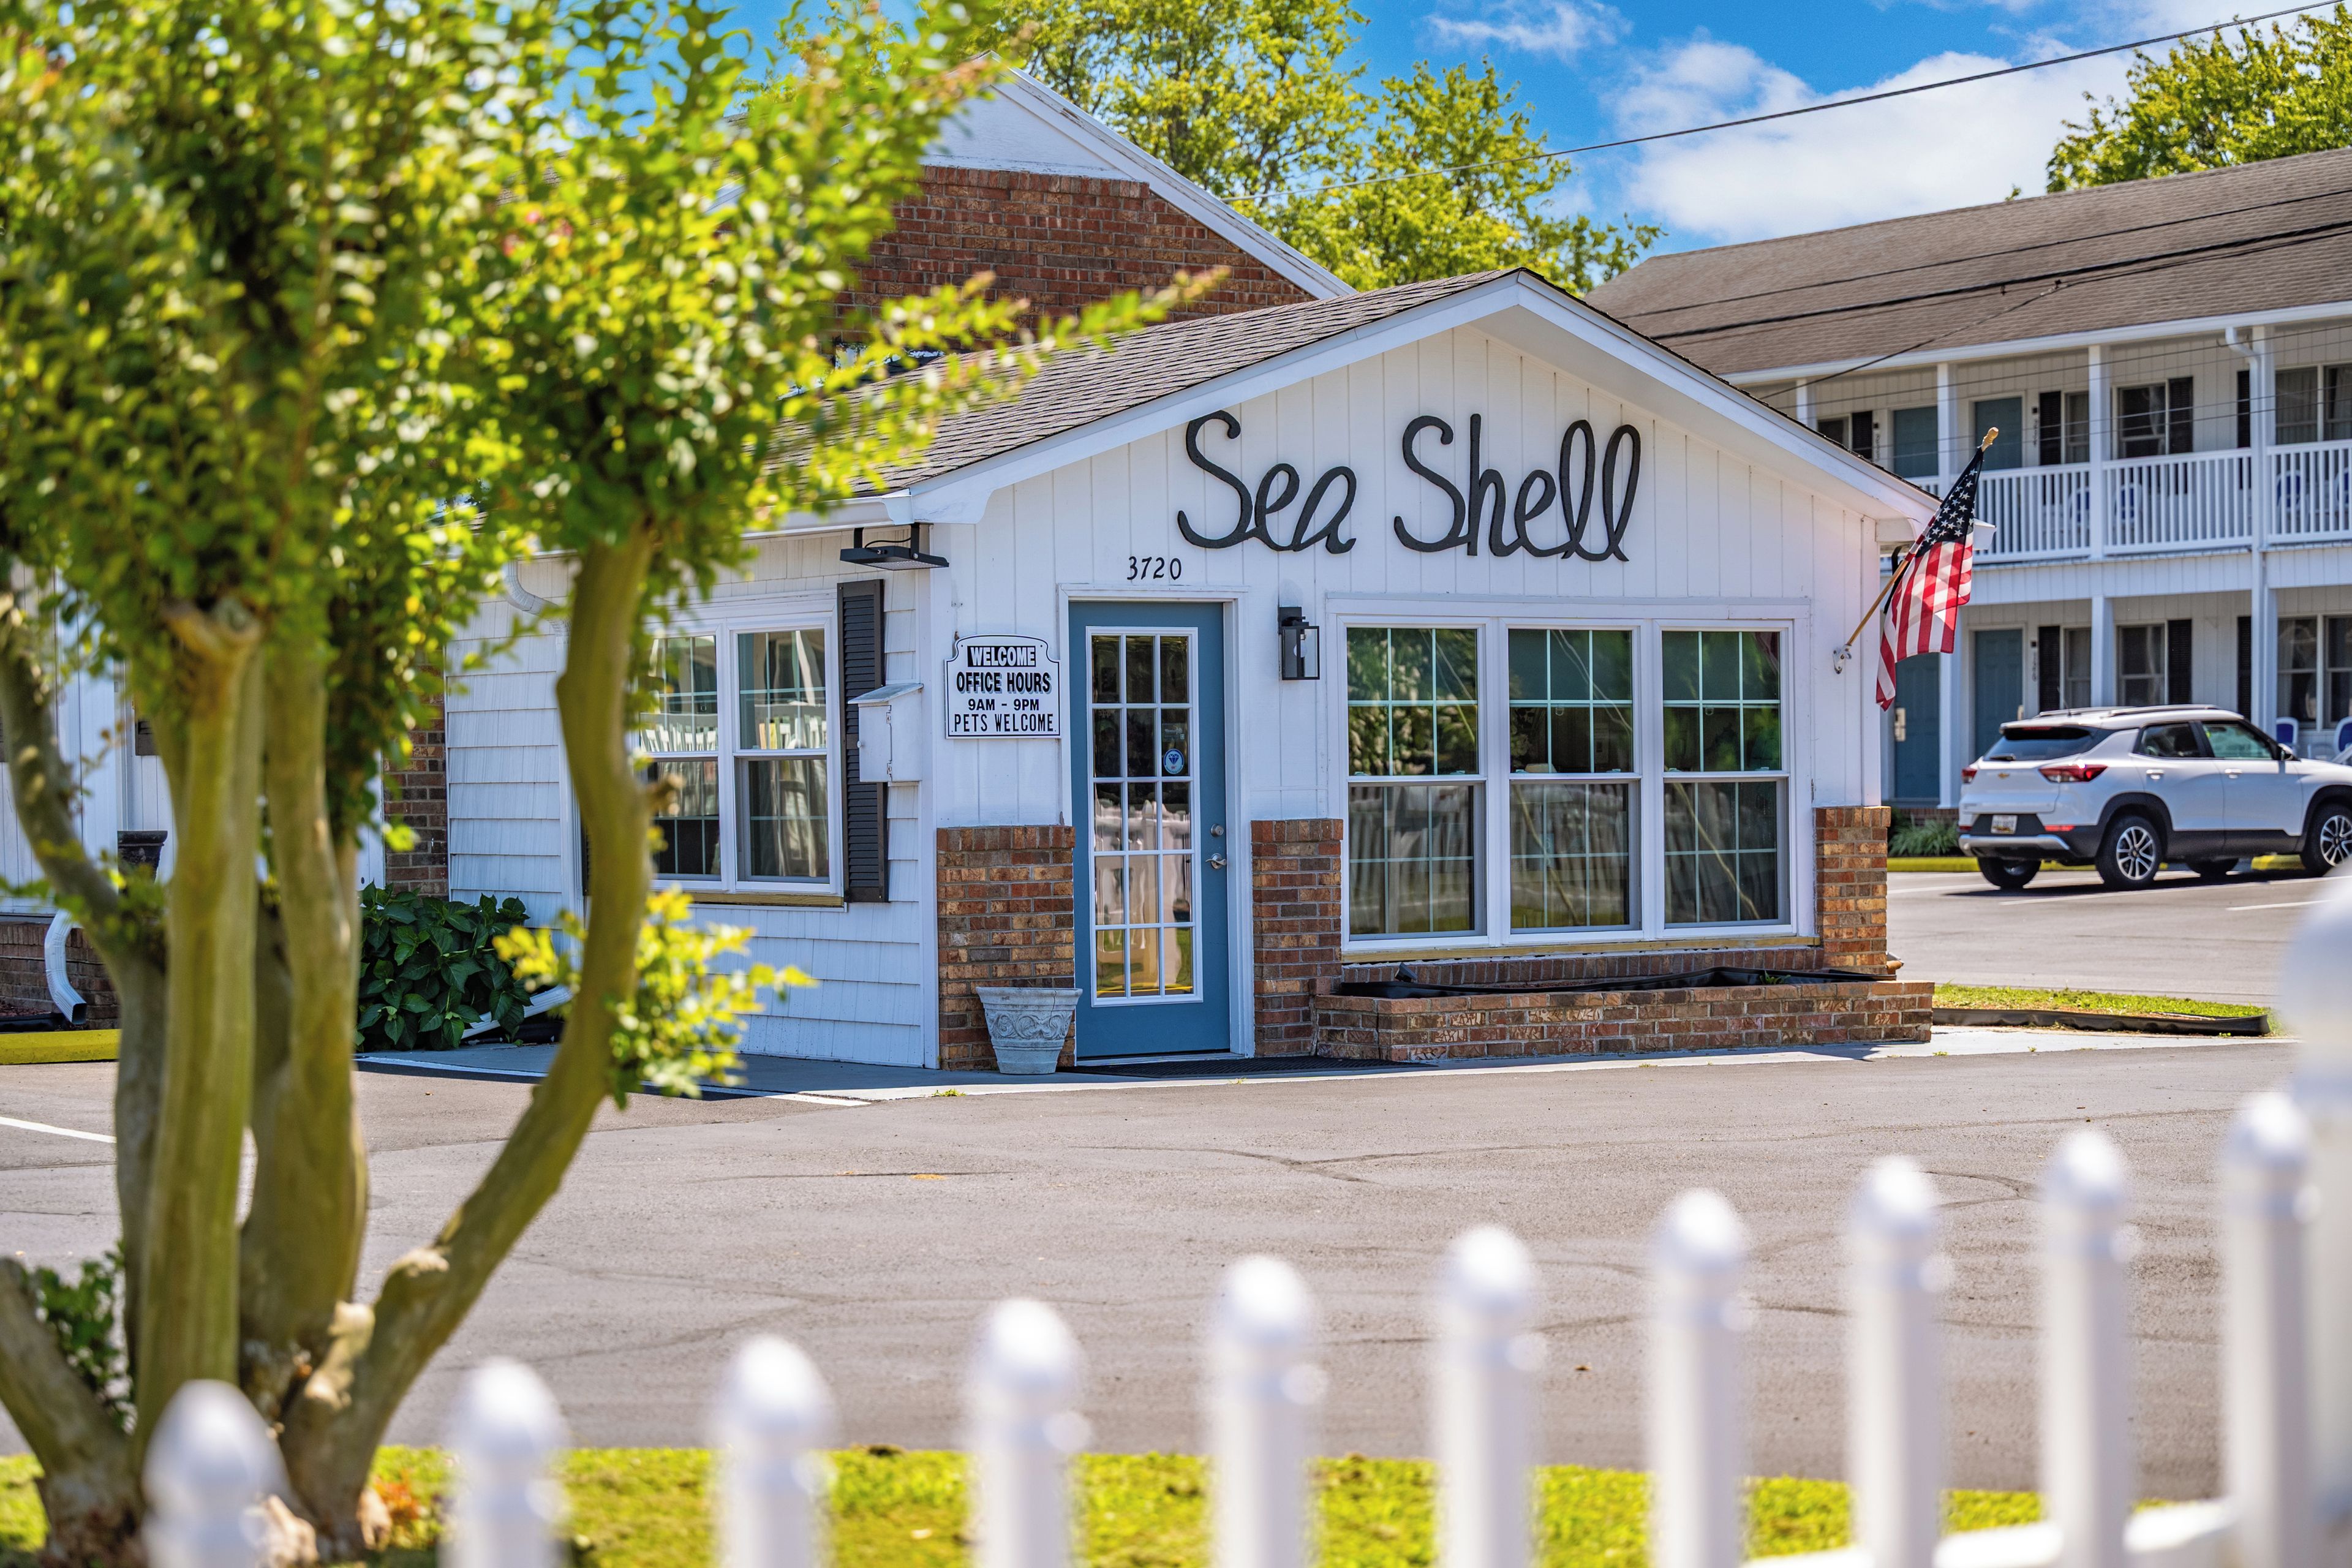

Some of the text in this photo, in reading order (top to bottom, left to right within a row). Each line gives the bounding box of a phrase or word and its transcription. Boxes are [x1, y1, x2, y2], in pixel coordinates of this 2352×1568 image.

[1177, 410, 1642, 562] Sea Shell
[1127, 556, 1182, 580] 3720
[970, 646, 1036, 666] WELCOME
[956, 671, 1052, 693] OFFICE HOURS
[968, 698, 995, 711] 9AM
[1013, 698, 1039, 711] 9PM
[954, 713, 1054, 732] PETS WELCOME
